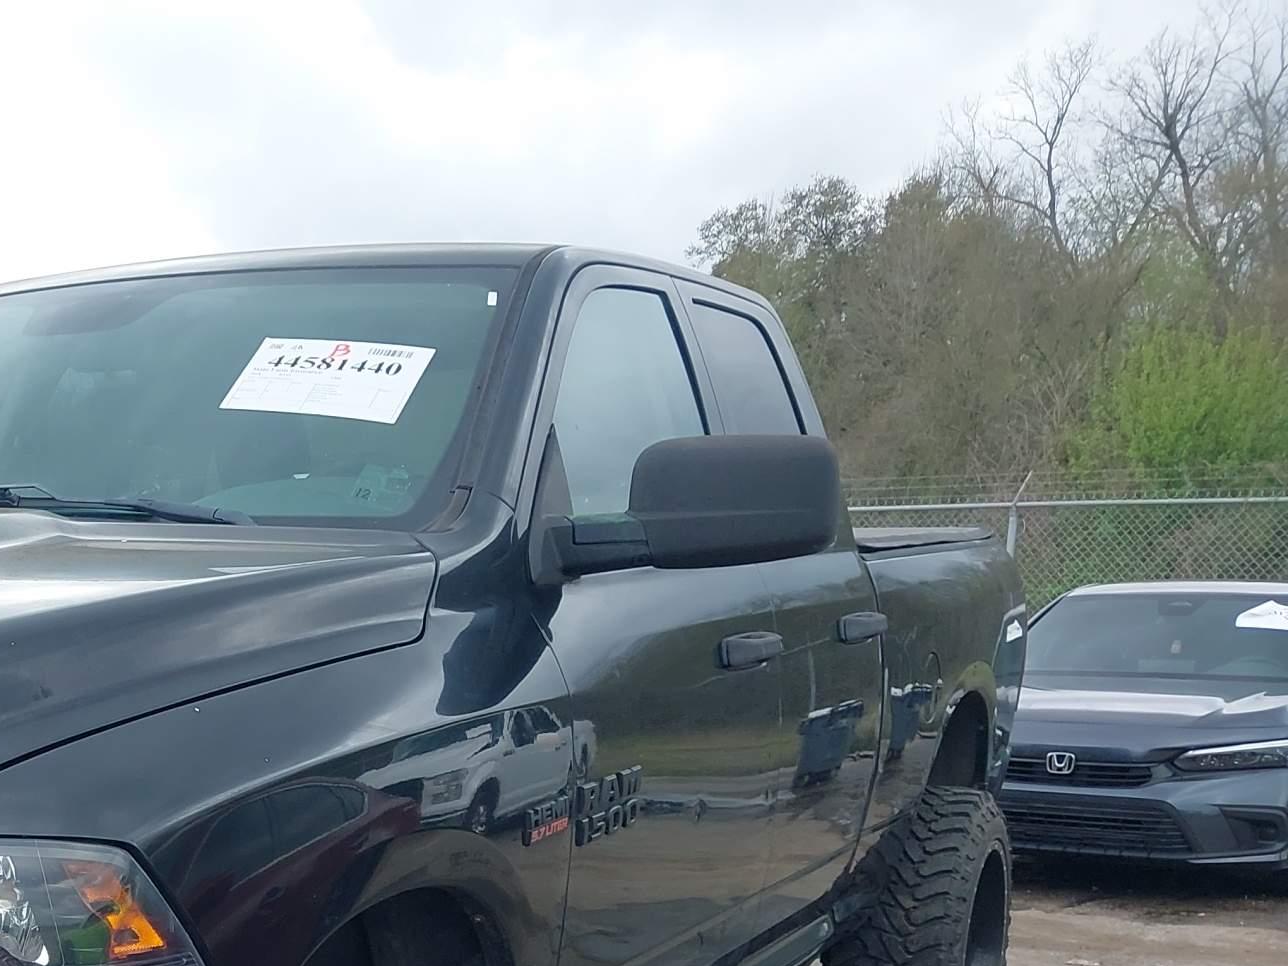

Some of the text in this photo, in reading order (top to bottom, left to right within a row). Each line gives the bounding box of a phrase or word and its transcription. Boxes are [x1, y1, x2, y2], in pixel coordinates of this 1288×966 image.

[268, 354, 403, 376] 44581440
[576, 765, 642, 816] RAM
[525, 796, 569, 832] HEMI
[575, 799, 639, 847] 1500
